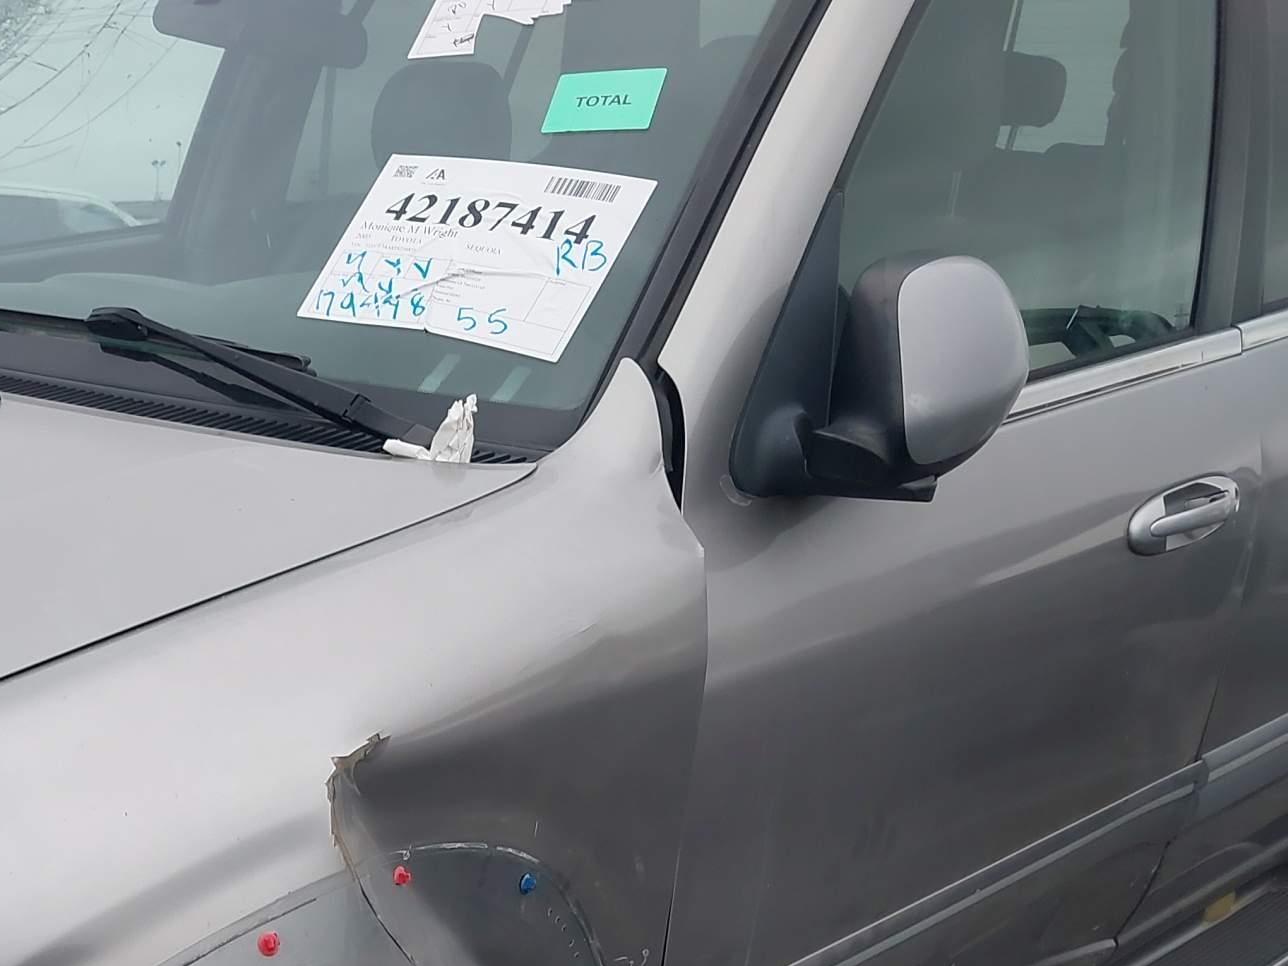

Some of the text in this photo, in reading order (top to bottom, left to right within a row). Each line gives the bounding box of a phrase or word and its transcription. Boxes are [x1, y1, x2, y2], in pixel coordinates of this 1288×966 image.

[575, 93, 632, 108] TOTAL
[385, 192, 597, 244] 42187414
[360, 220, 459, 240] Monique M Wright
